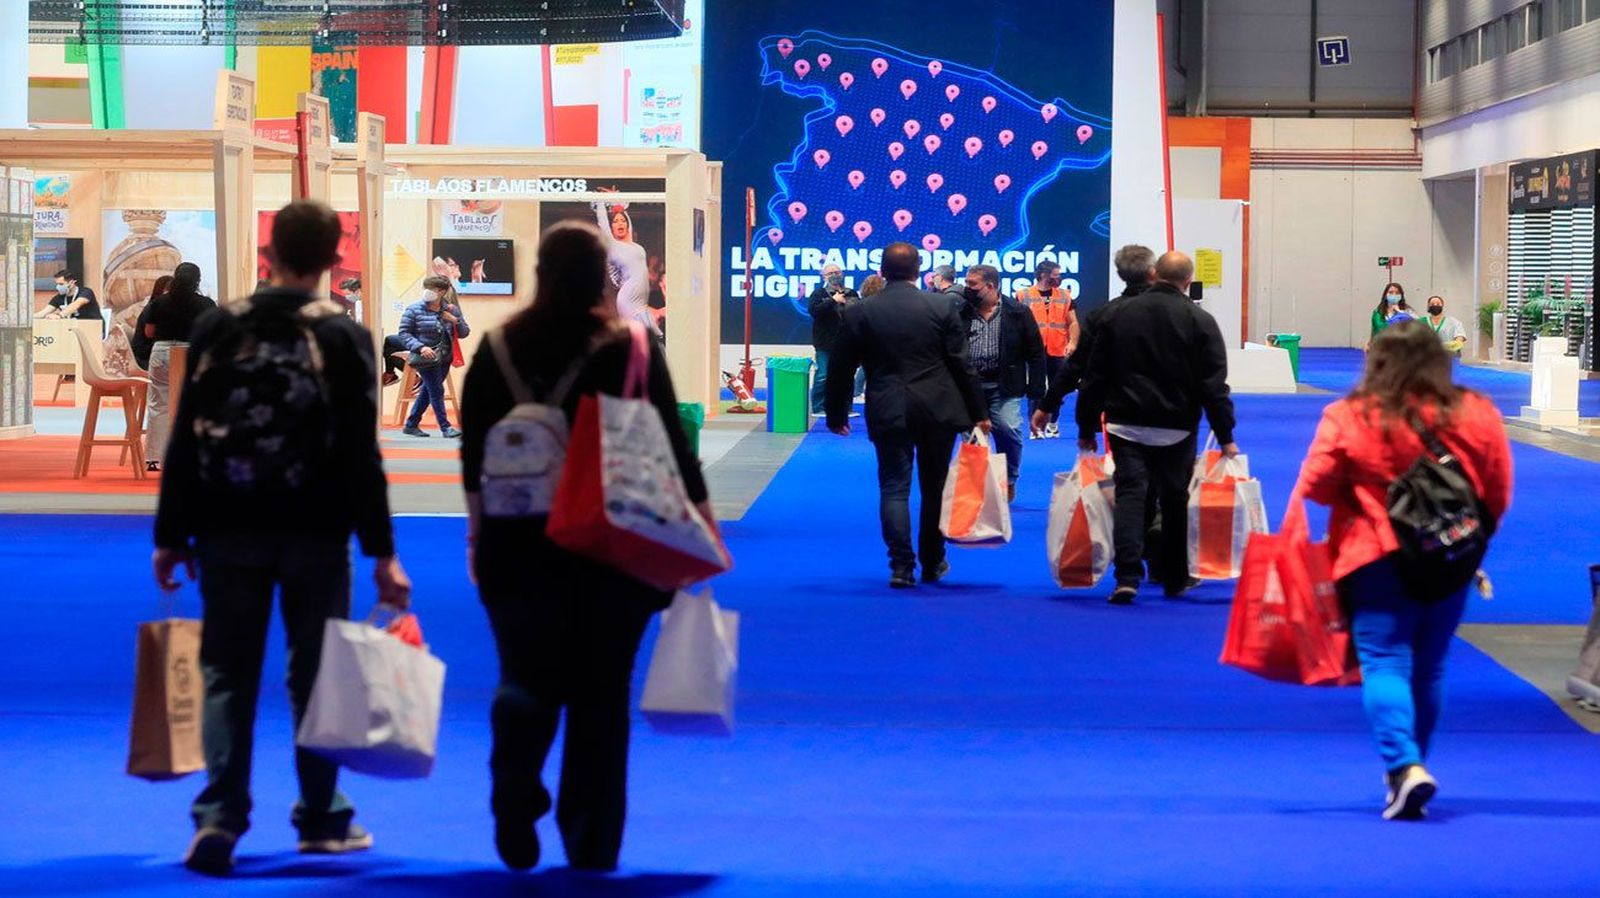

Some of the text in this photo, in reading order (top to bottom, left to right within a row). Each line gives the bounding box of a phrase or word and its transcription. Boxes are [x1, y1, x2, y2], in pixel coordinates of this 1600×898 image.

[311, 50, 358, 71] SPAIN
[389, 179, 588, 193] TABLAOS FLAMENCOS
[449, 213, 497, 225] TABLAOS
[731, 244, 1079, 273] LA TRANSORMACIÓN
[730, 274, 855, 298] DIGITL
